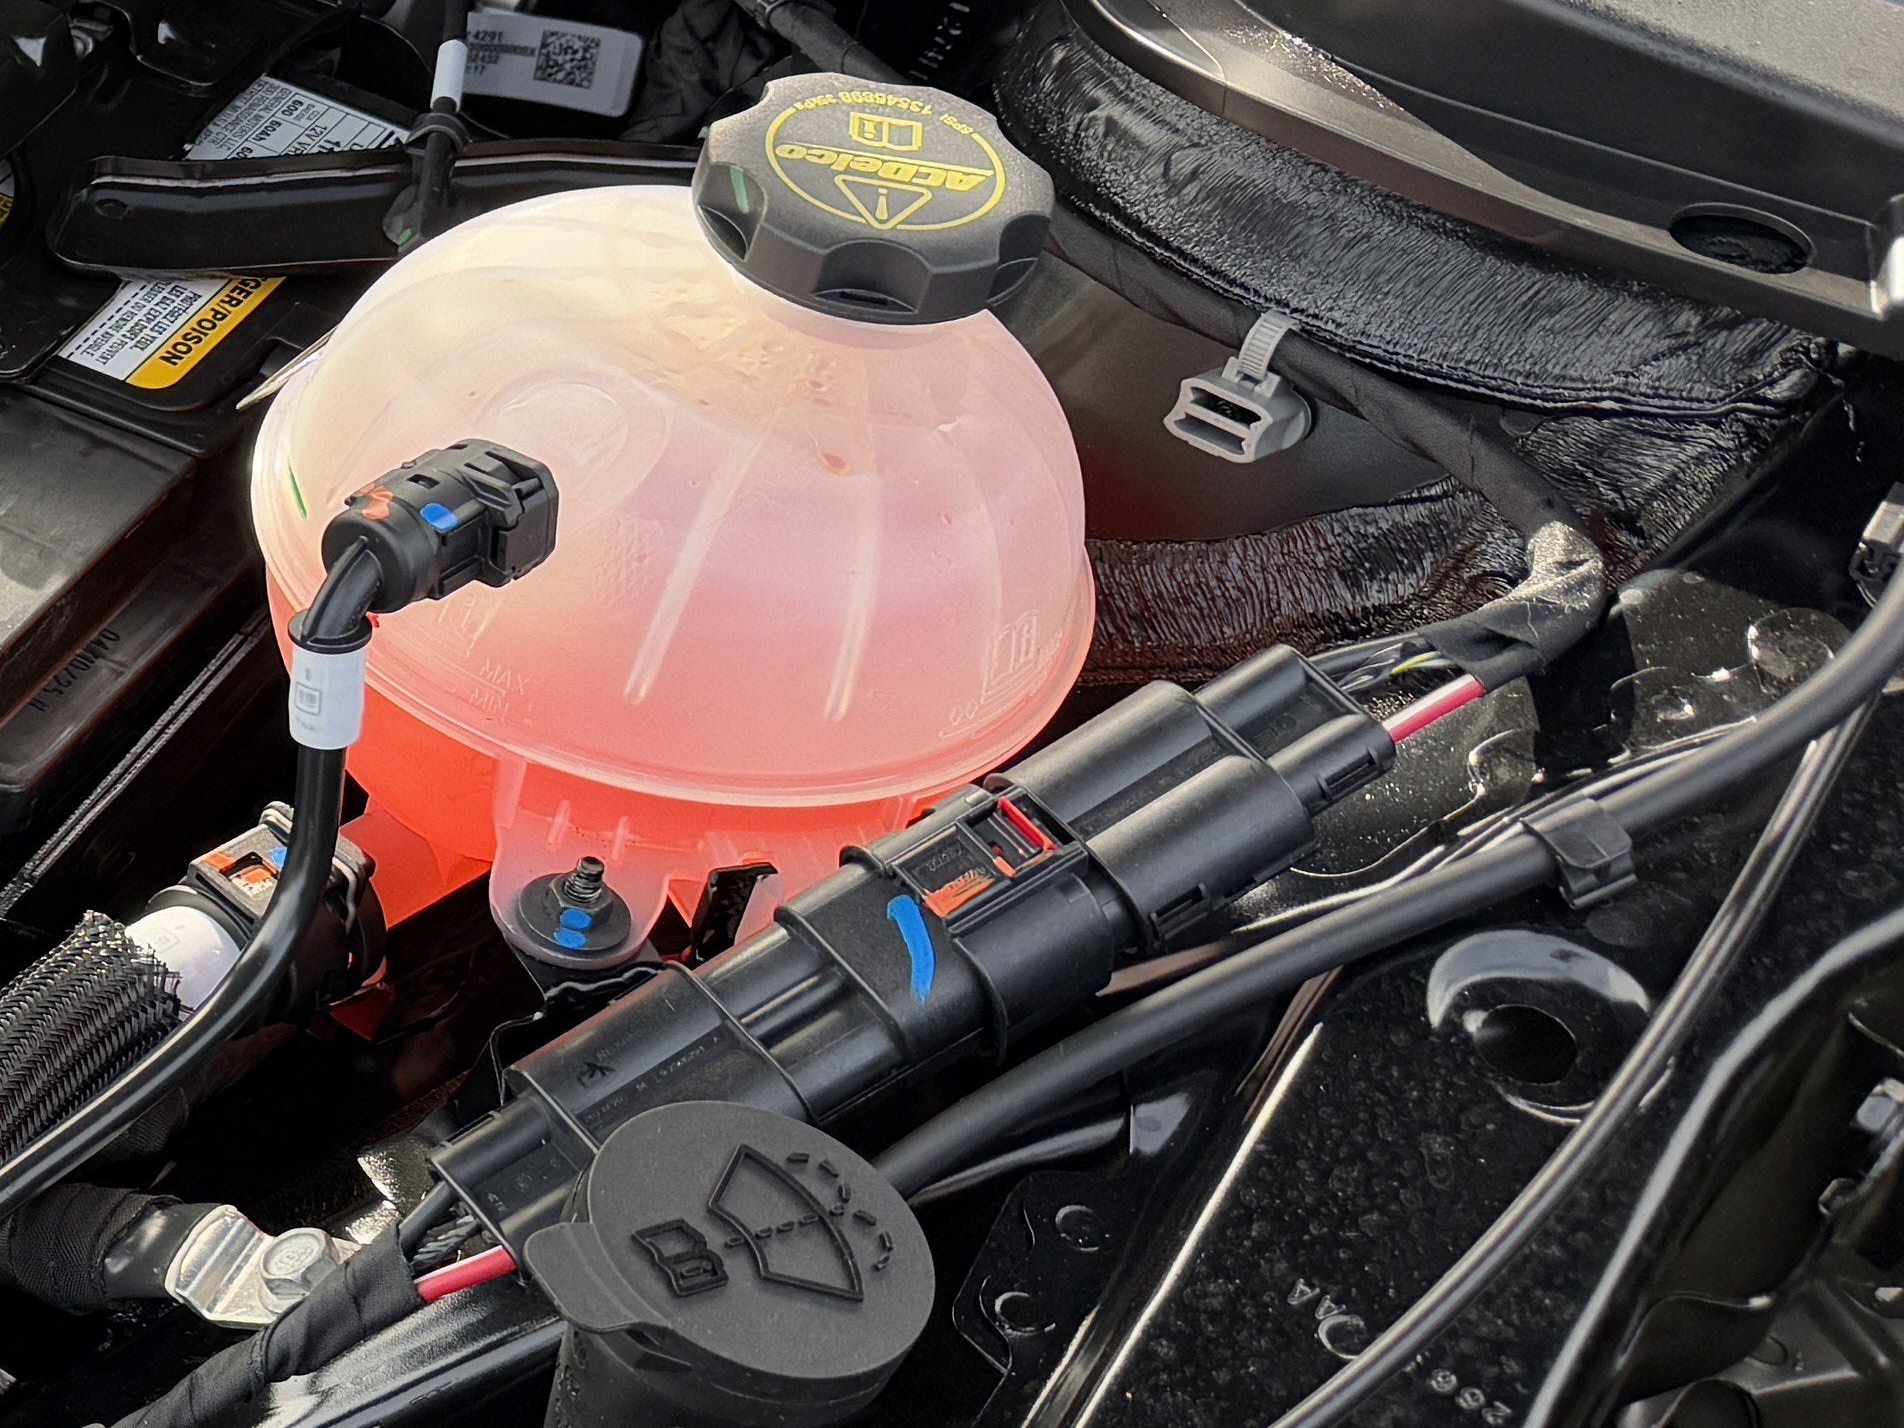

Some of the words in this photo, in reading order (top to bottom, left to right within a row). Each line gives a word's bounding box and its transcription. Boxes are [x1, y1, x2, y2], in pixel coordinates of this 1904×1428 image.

[257, 87, 293, 114] GENERAL
[279, 98, 305, 117] 600
[230, 112, 265, 139] MOTORS
[251, 118, 283, 143] 60Ah
[301, 122, 328, 141] 12V
[774, 144, 986, 191] ACDelco
[159, 276, 263, 366] GER/POISON
[479, 658, 533, 695] MAX
